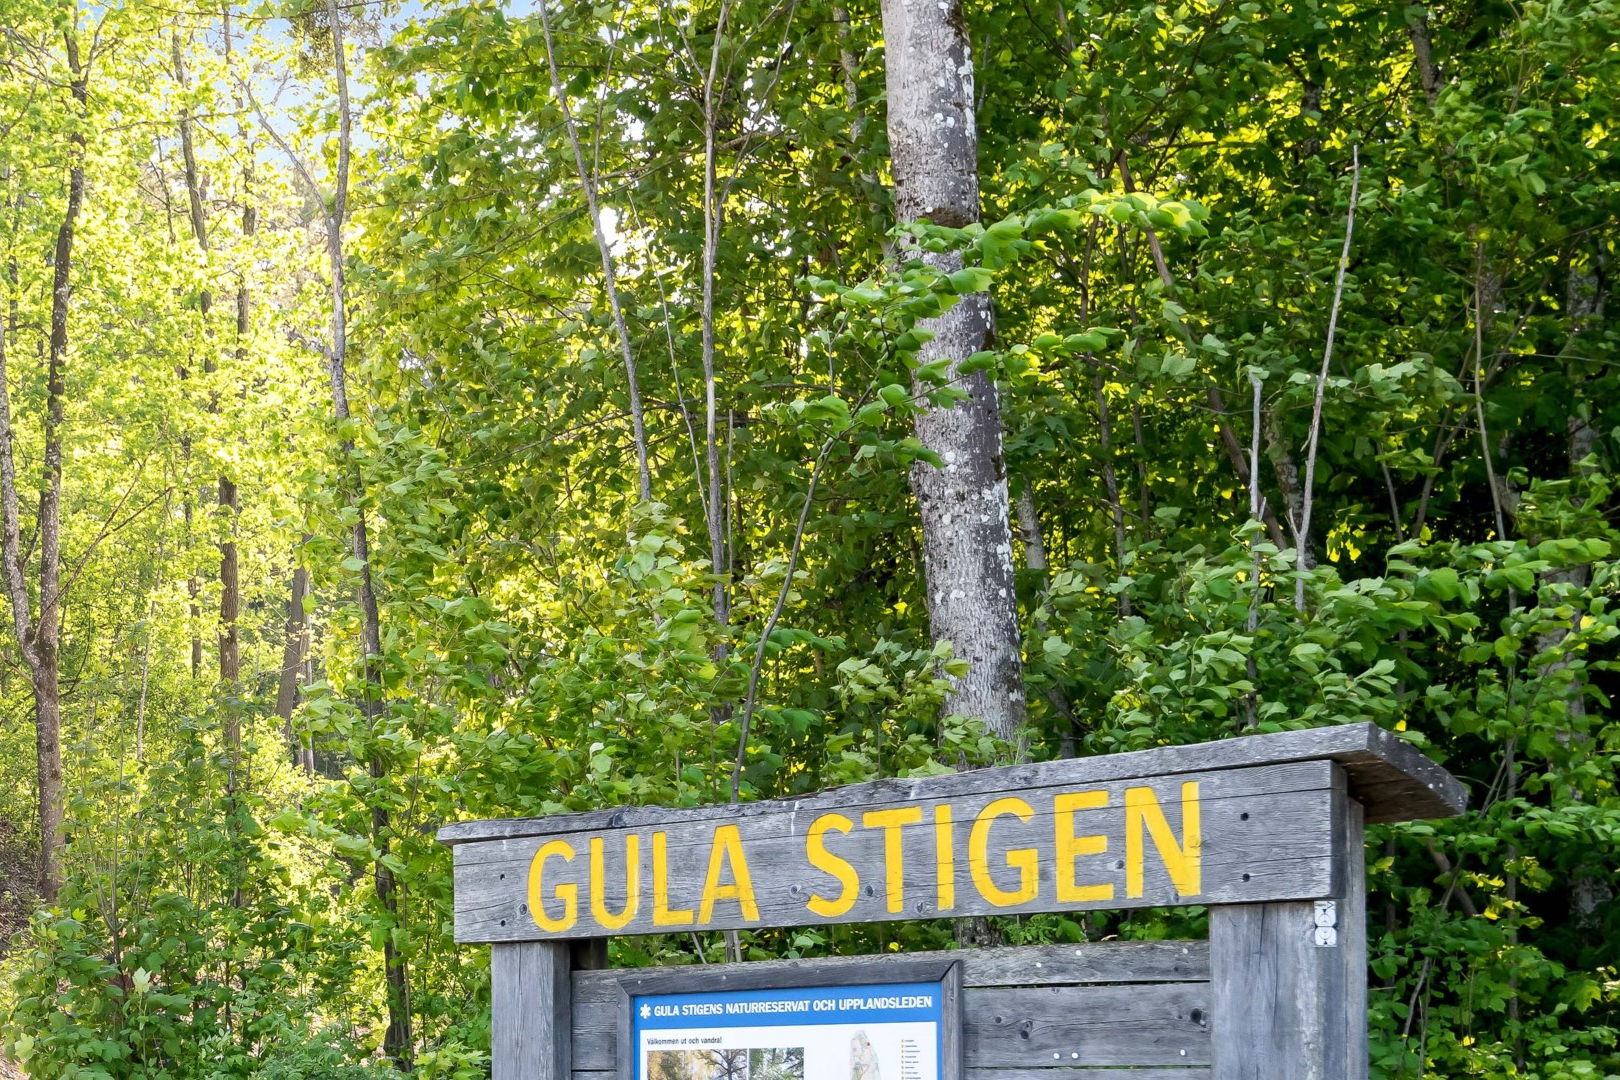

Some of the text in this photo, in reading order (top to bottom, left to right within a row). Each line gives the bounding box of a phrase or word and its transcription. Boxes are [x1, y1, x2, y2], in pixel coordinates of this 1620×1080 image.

[527, 781, 1201, 932] GULA STIGEN
[654, 995, 932, 1017] GULA STIGENS NATURRESERVAT OCH UPPLANDSLEDEN
[647, 1037, 679, 1045] Välkommen
[701, 1036, 722, 1044] vandra!
